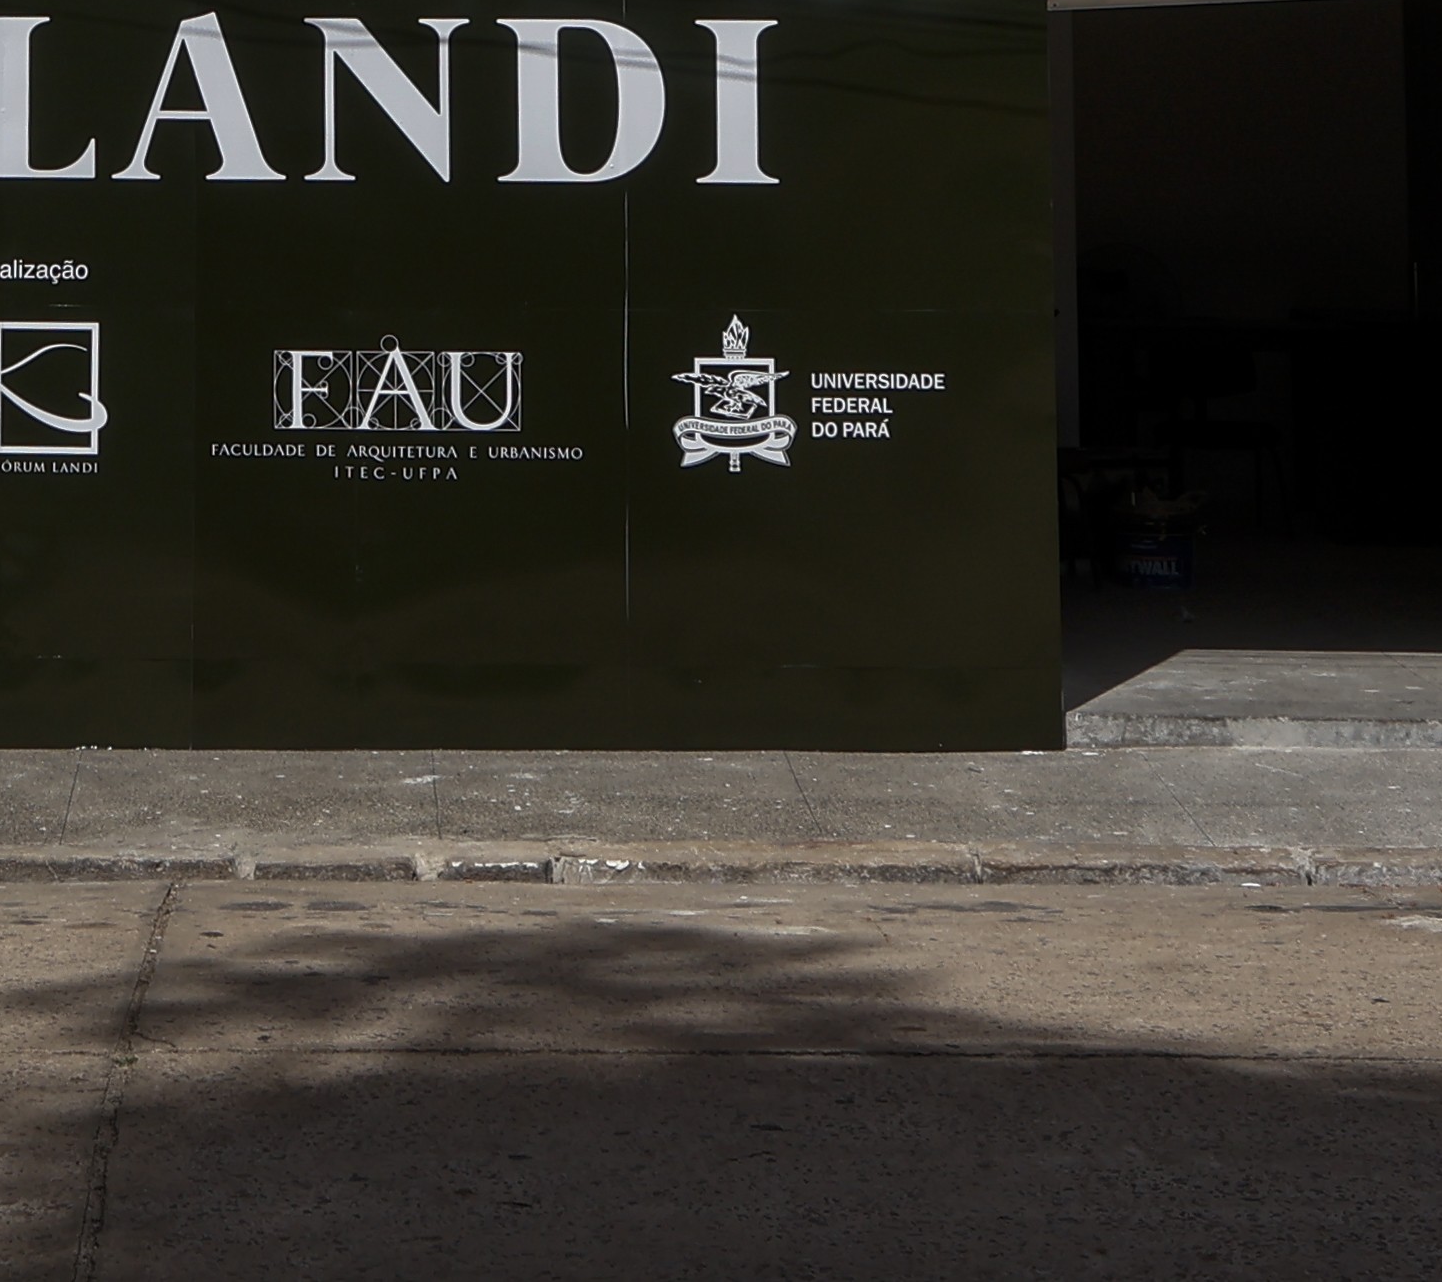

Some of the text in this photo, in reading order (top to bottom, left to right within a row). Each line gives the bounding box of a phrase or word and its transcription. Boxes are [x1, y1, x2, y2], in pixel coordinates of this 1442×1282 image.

[286, 343, 517, 431] FAU
[811, 372, 946, 390] UNIVERSIDADE
[811, 397, 893, 414] FEDERAL
[811, 418, 890, 438] DO PARÁ
[211, 443, 583, 463] FACULDADE DE ARQUITETURA E URBANISMO
[52, 461, 98, 474] LANDI
[334, 465, 458, 480] ITEC-UFPA
